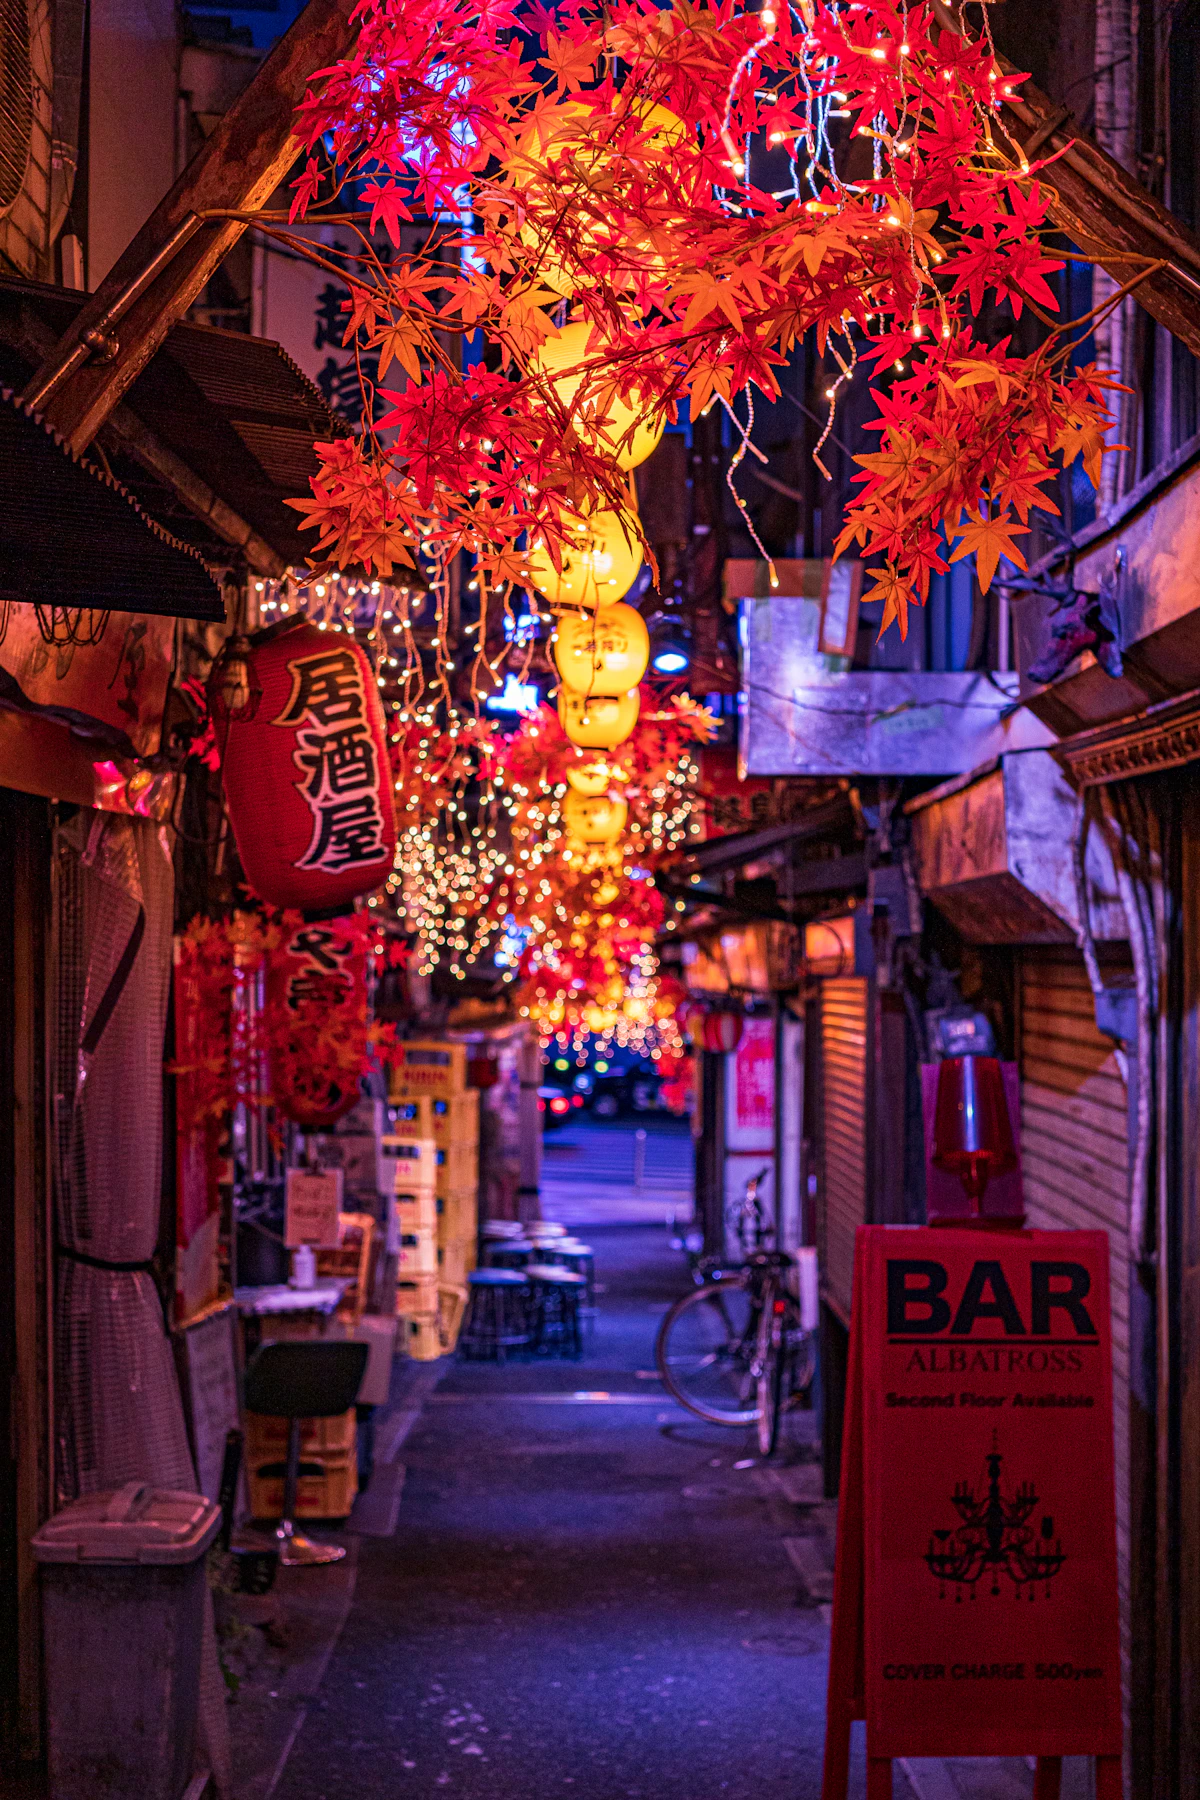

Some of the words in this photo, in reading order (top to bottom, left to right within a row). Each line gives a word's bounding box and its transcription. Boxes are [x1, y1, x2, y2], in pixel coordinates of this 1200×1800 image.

[272, 648, 388, 873] 居酒屋
[887, 1260, 1097, 1335] BAR
[906, 1350, 1083, 1373] ALBATROSS
[886, 1392, 954, 1408] Second
[960, 1392, 1006, 1408] Floor
[1012, 1393, 1094, 1408] Available
[882, 1664, 945, 1680] COVER
[951, 1664, 1025, 1680] CHARGE
